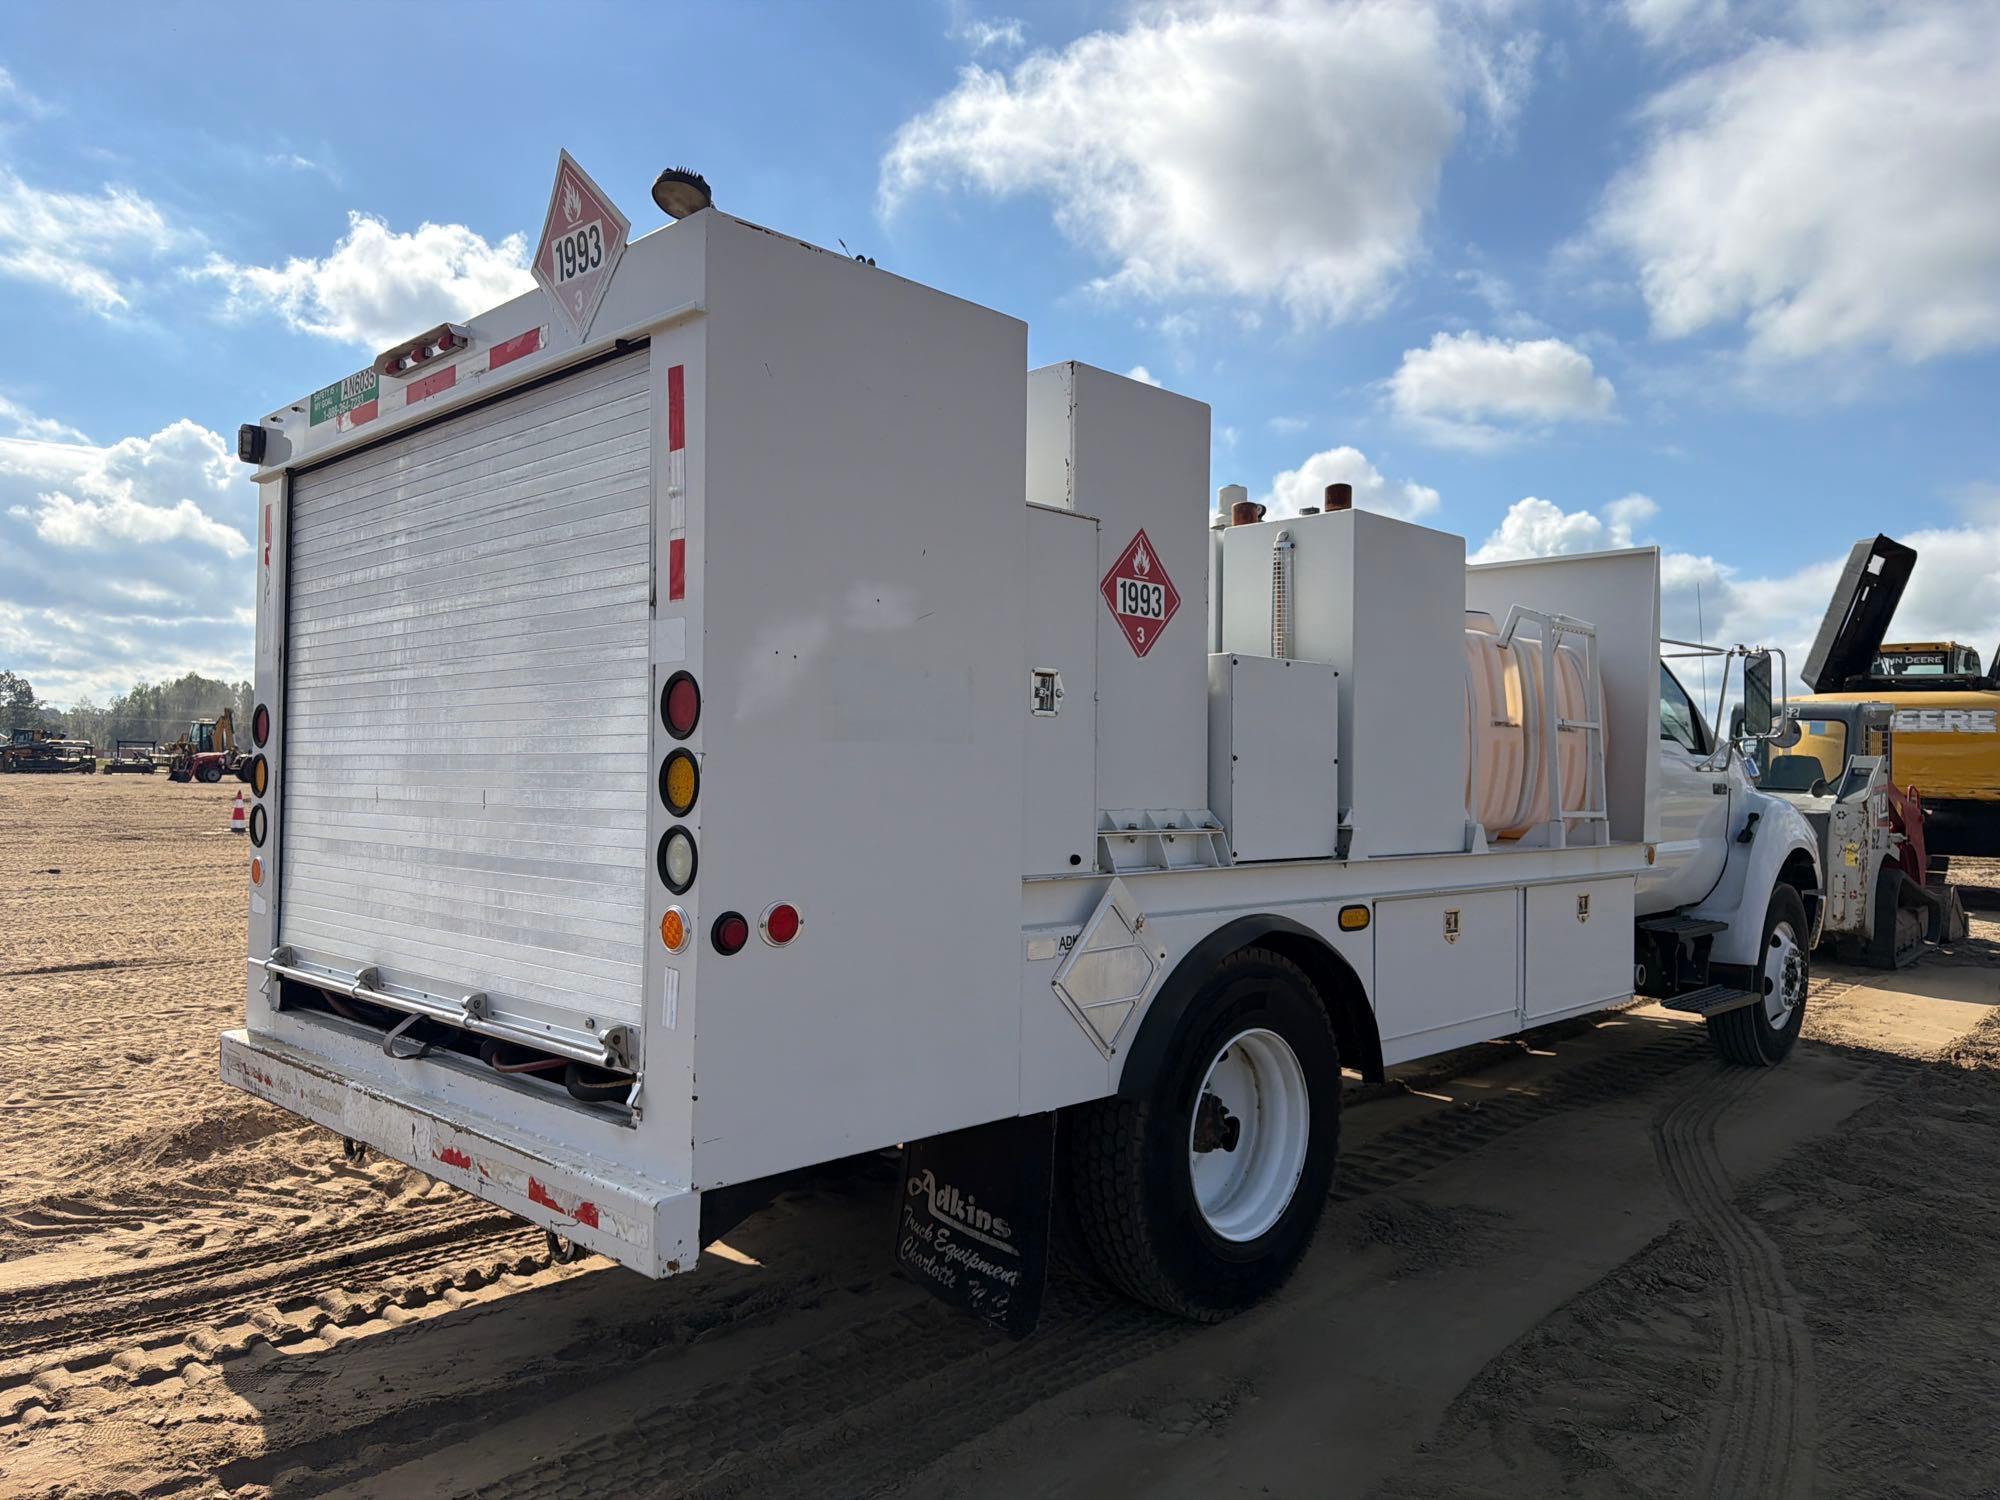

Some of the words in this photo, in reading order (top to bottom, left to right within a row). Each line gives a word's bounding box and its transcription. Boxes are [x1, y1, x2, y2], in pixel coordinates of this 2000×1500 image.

[555, 225, 602, 282] 1993
[575, 290, 583, 312] 3
[343, 370, 375, 399] AN6035
[1120, 580, 1162, 618] 1993
[1137, 626, 1145, 643] 3
[1905, 656, 1942, 664] DEERE
[907, 1168, 1013, 1241] Adkins
[904, 1205, 932, 1242] Truck
